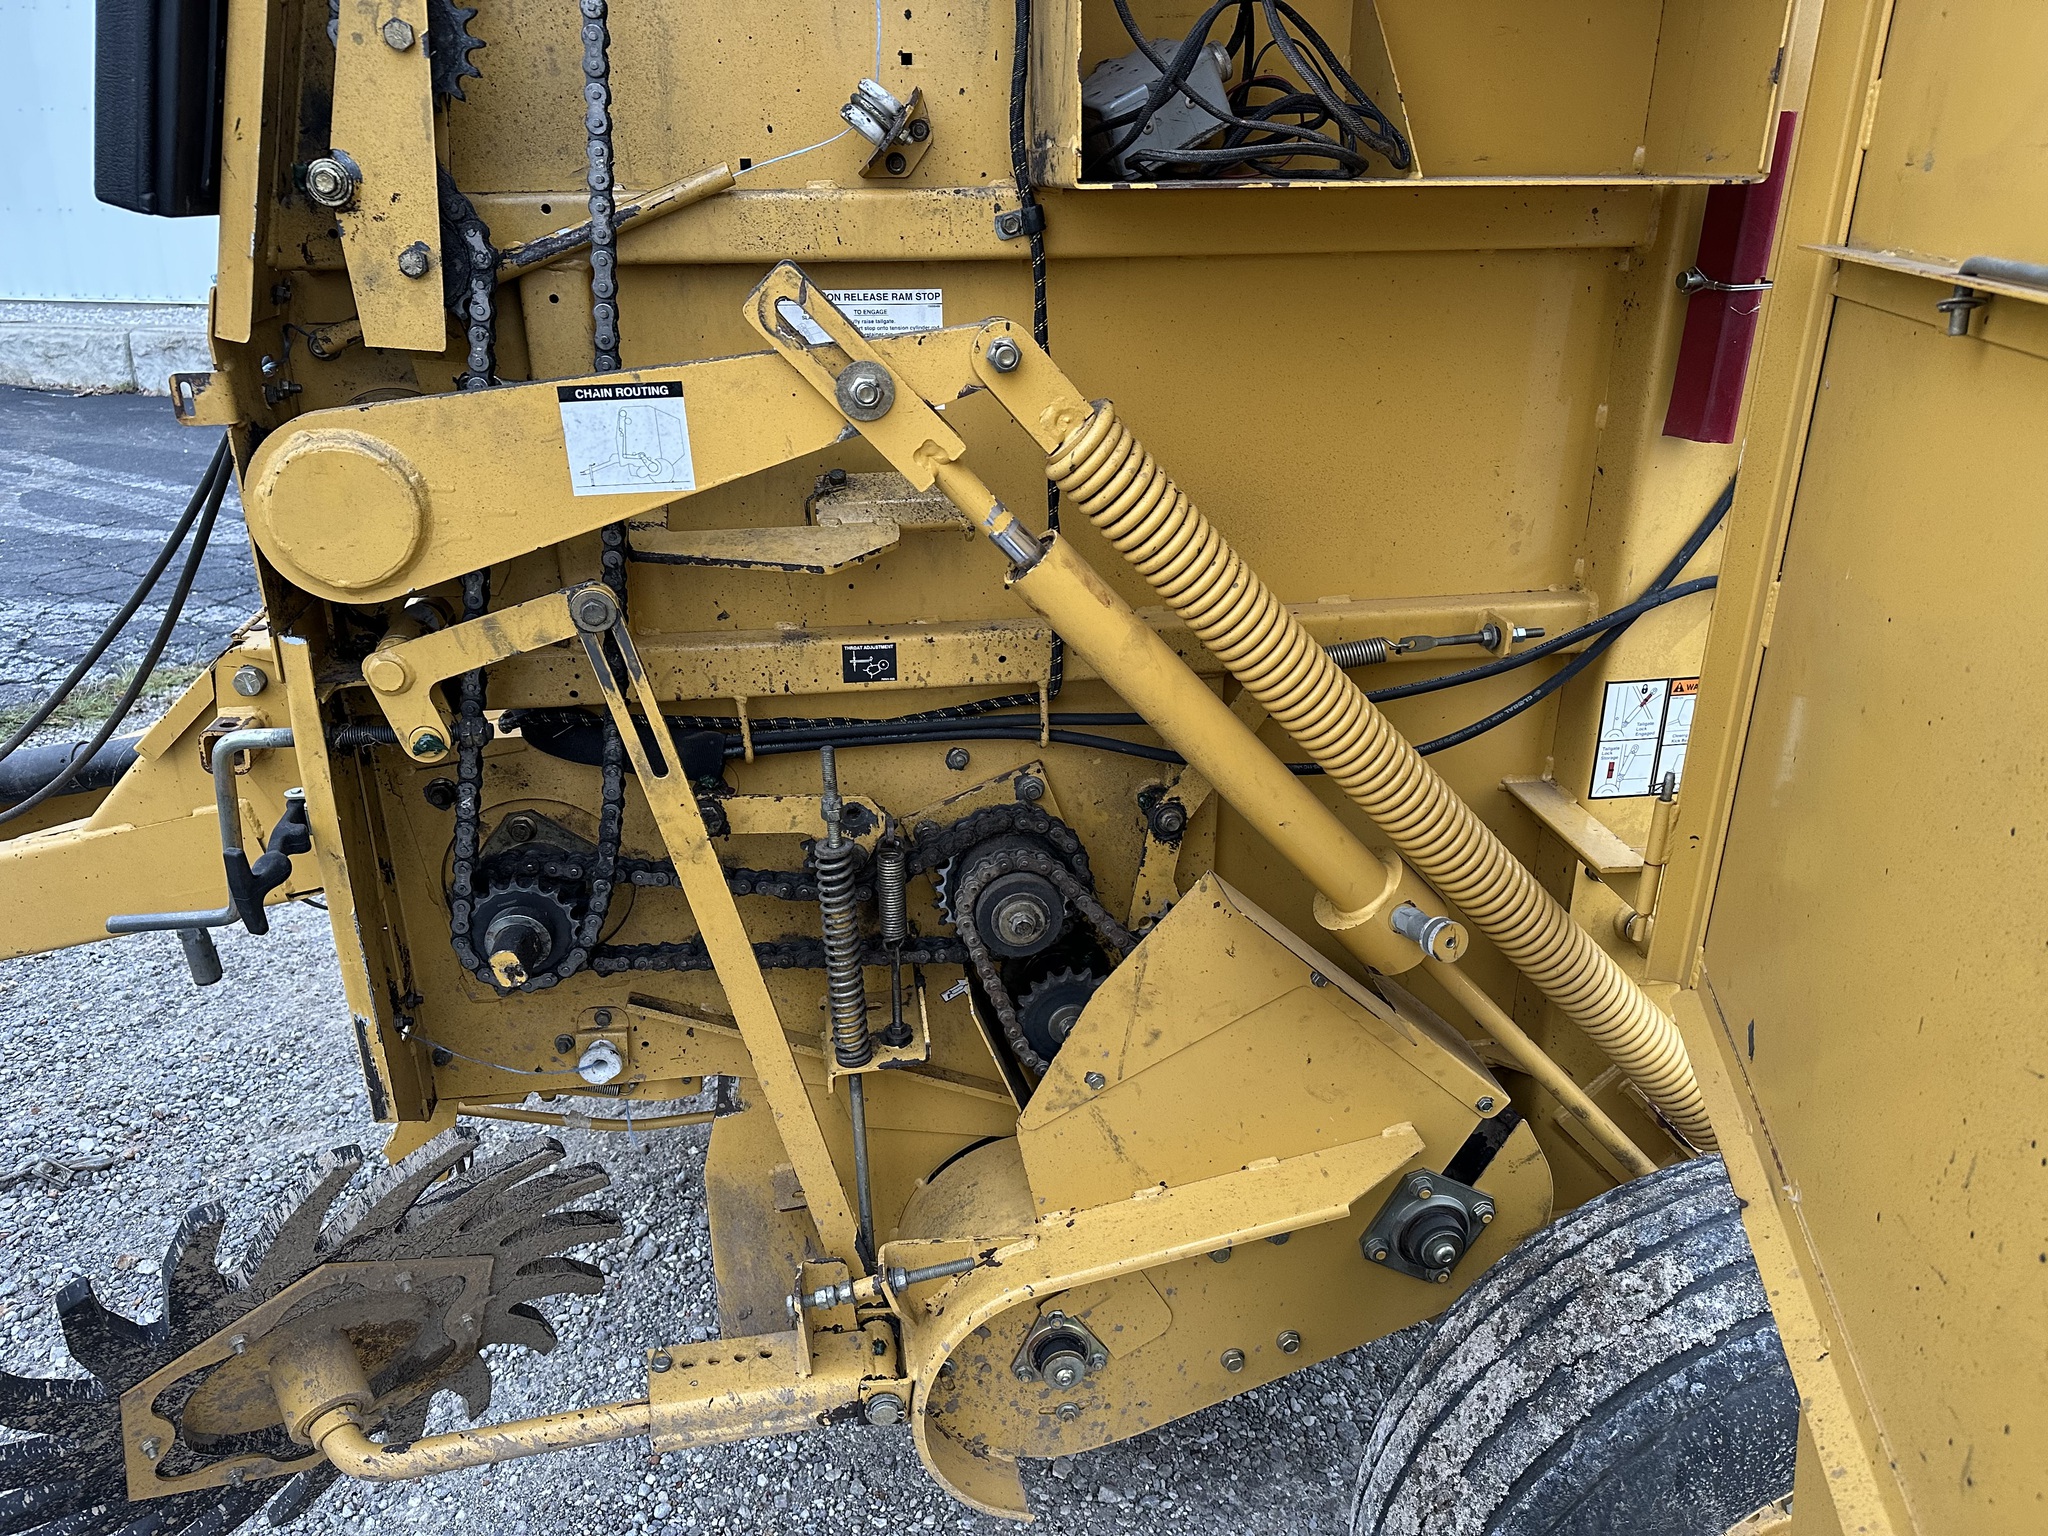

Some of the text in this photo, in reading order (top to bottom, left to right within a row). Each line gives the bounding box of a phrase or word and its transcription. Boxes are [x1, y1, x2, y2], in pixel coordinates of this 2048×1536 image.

[844, 293, 888, 301] RELEASE
[915, 292, 941, 300] STOP
[575, 385, 669, 399] CHAIN ROUTING
[1503, 694, 1533, 715] GLOBAL
